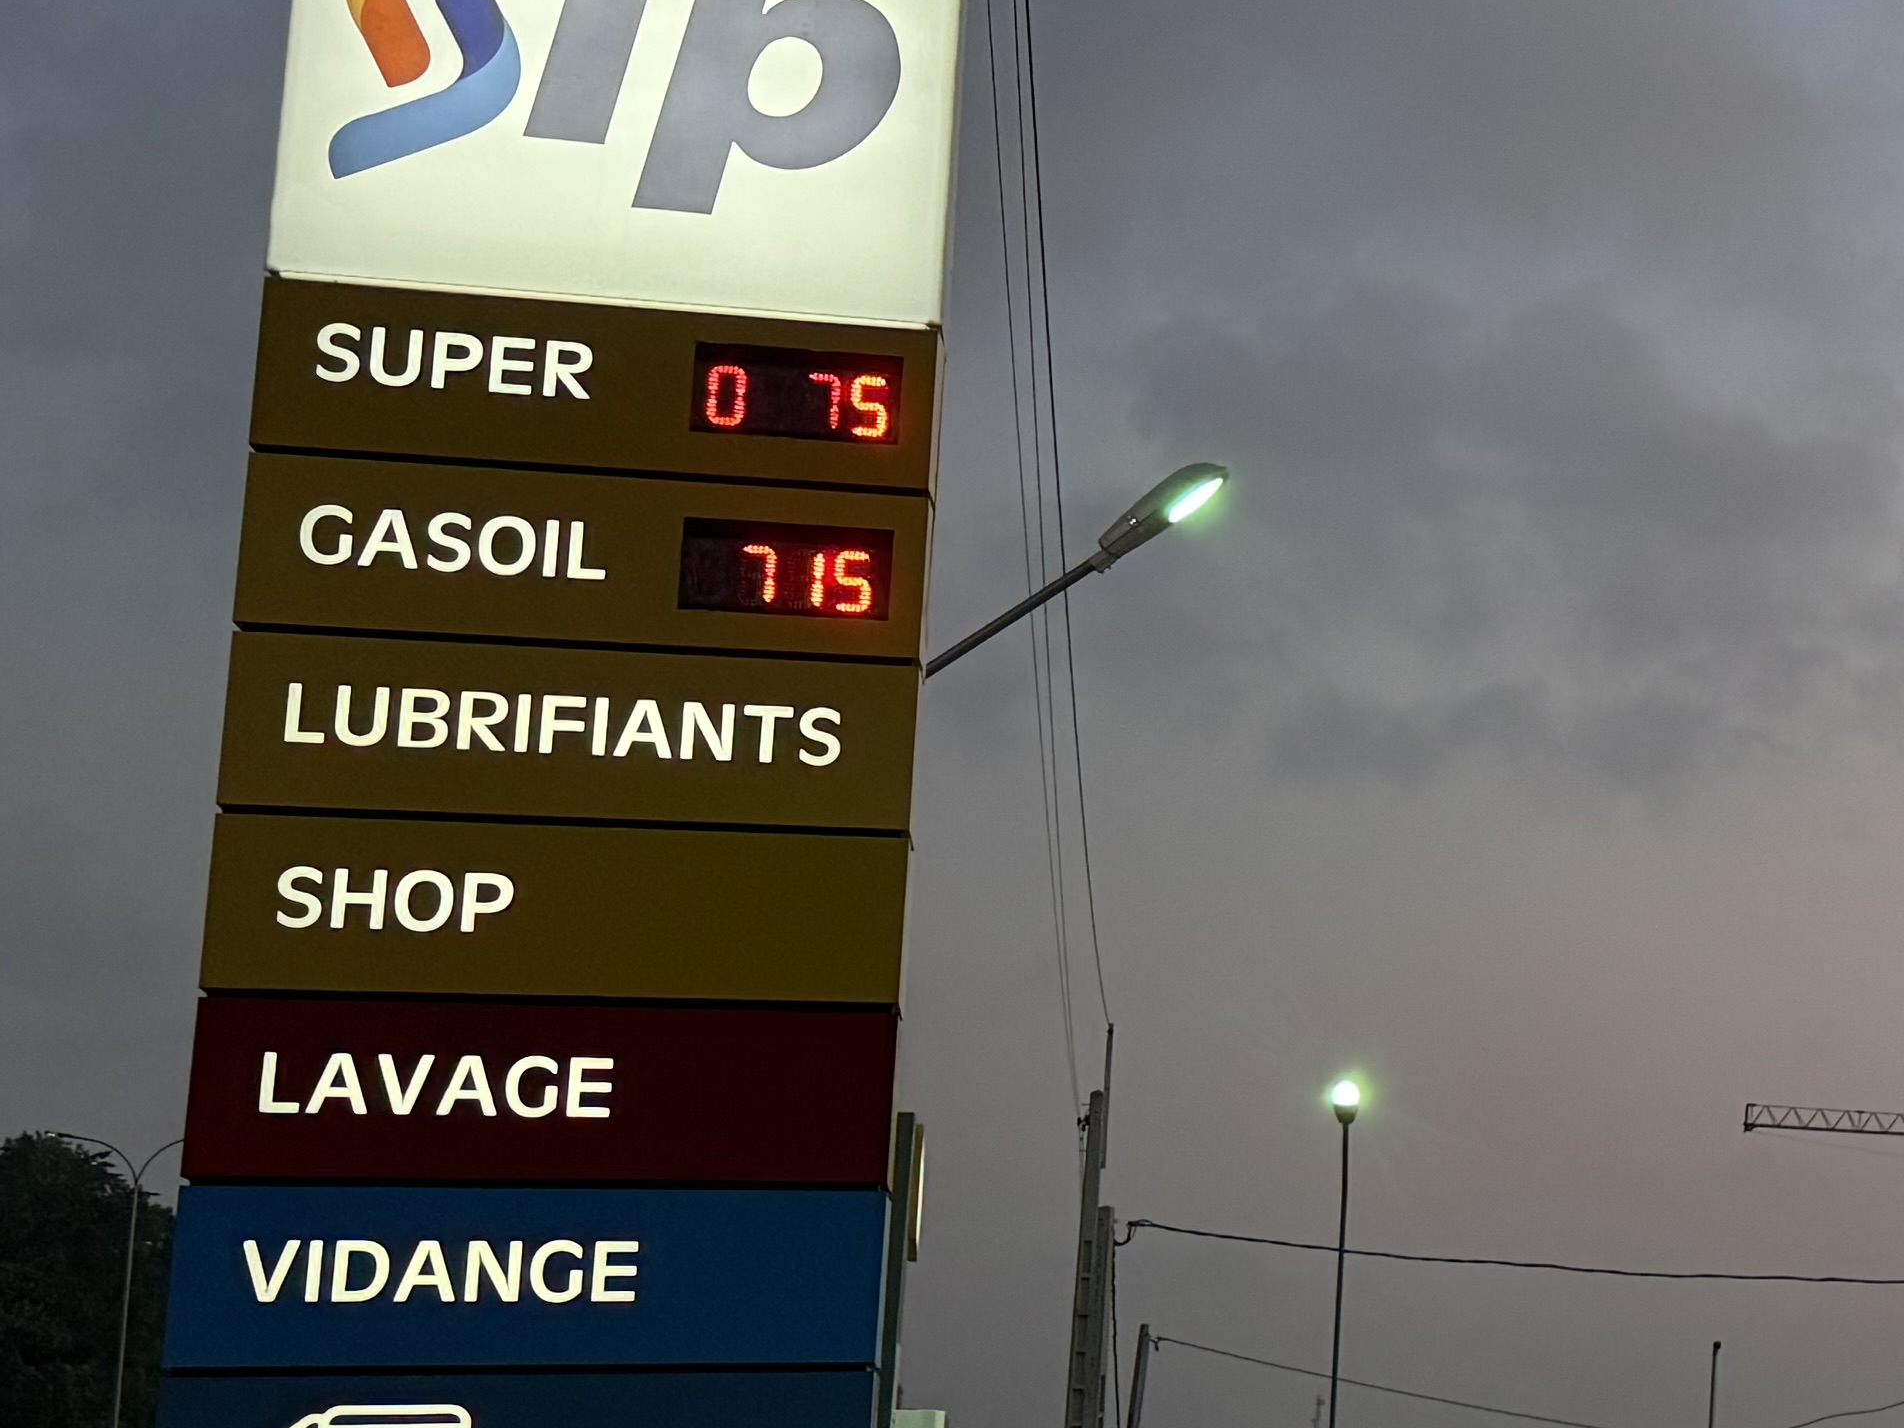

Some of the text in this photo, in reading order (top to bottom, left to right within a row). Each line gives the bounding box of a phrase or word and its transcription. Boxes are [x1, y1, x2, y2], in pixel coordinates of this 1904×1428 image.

[315, 322, 594, 400] SUPER
[299, 504, 607, 581] GASOIL
[743, 544, 873, 613] 715
[284, 682, 842, 767] LUBRIFIANTS
[276, 865, 515, 933] SHOP
[258, 1051, 615, 1119] LAVAGE
[242, 1239, 640, 1304] VIDANGE
